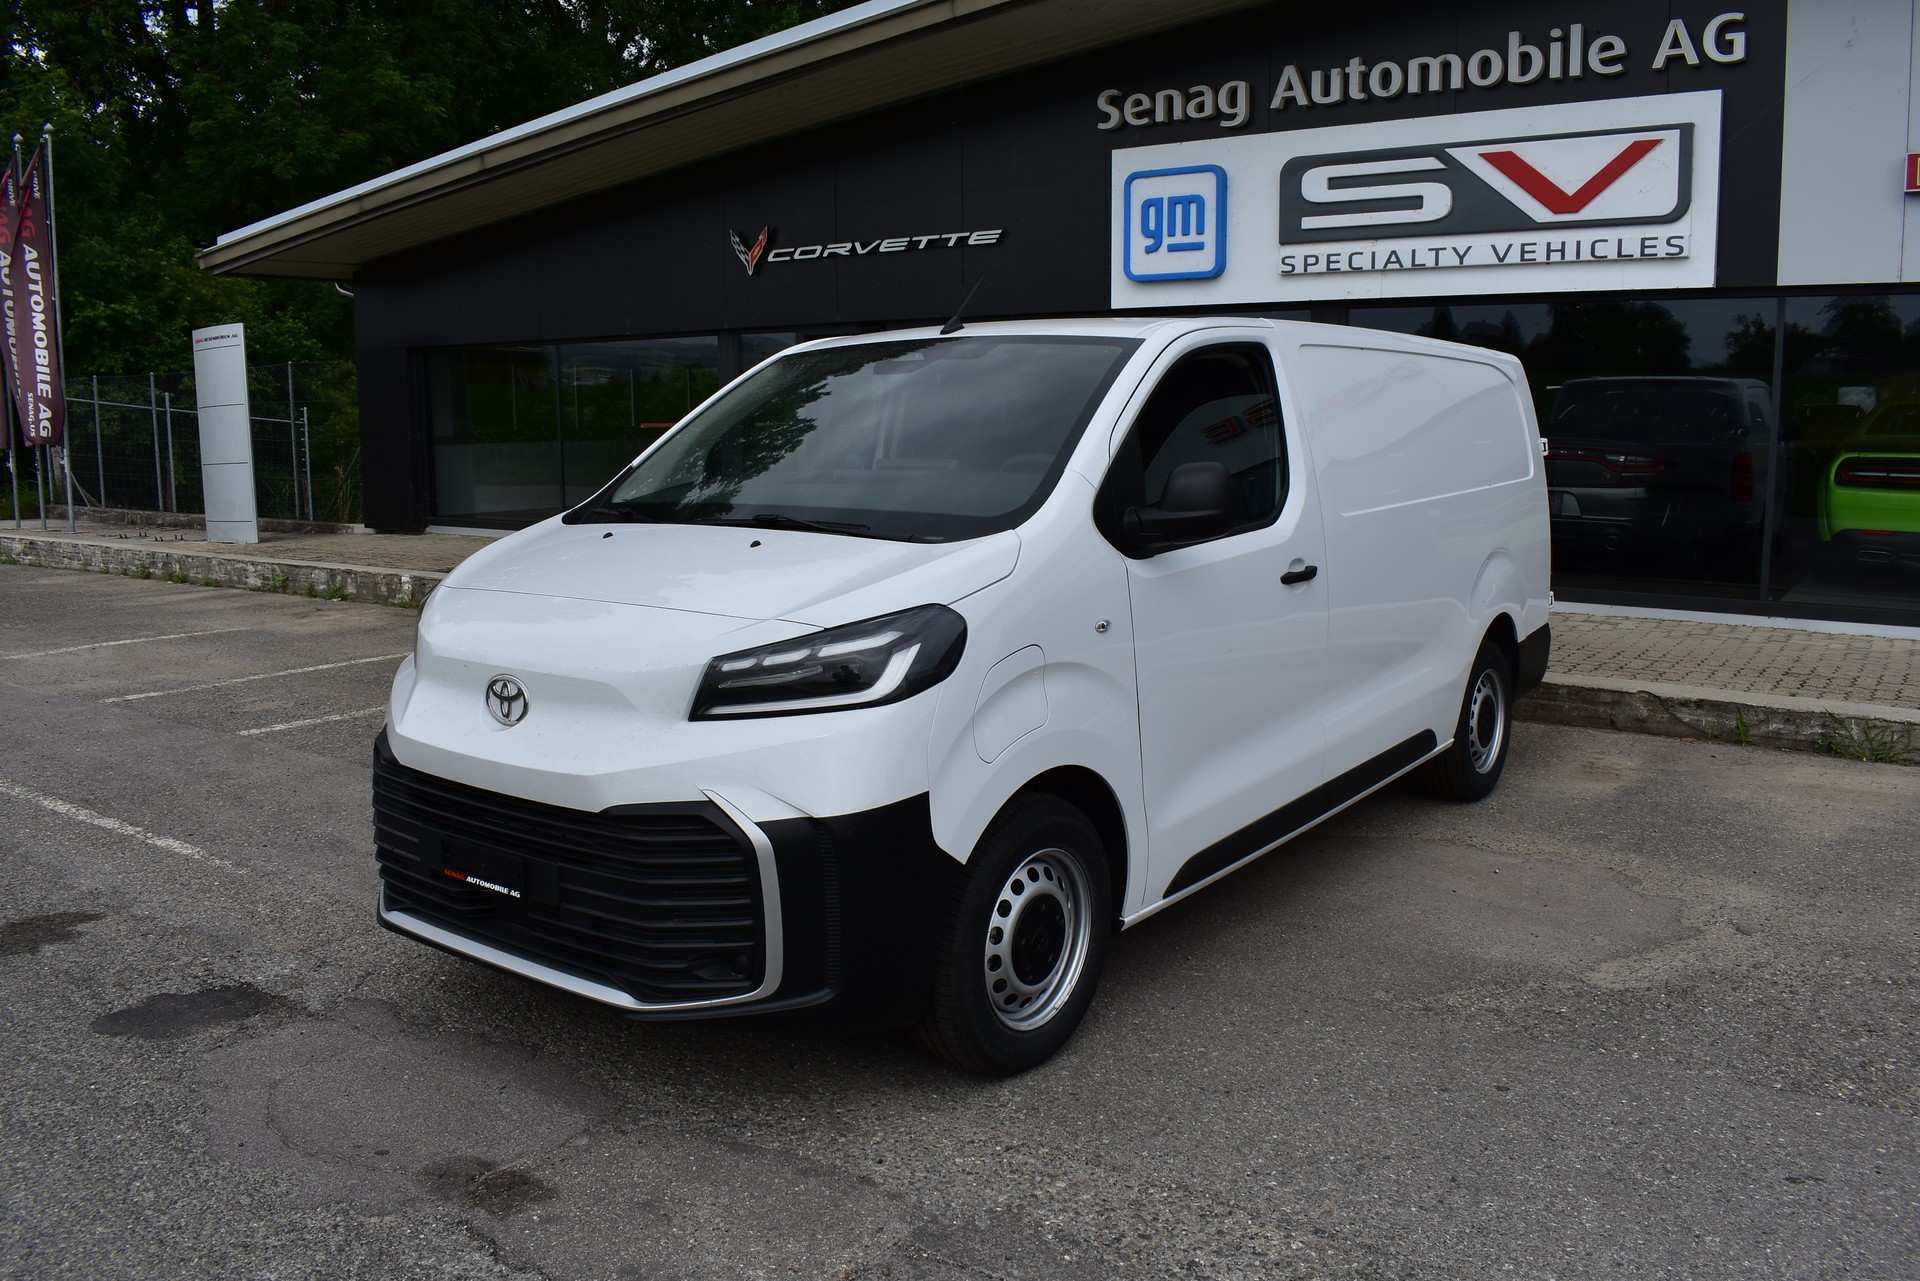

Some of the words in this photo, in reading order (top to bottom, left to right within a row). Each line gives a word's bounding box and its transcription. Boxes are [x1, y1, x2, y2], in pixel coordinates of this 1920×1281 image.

[1097, 80, 1251, 130] Senag
[1270, 23, 1628, 111] Automobile
[1652, 12, 1747, 71] AG
[767, 229, 1002, 262] CORVETTE
[1280, 245, 1474, 275] SPECIALTY
[1490, 235, 1686, 264] VEHICLES
[23, 243, 52, 399] AUTOMOBILE
[38, 402, 52, 438] AG
[28, 392, 36, 437] SENAG.US
[444, 869, 465, 881] SENAG
[466, 876, 509, 895] AUTOMOBILE
[509, 889, 521, 898] AG
